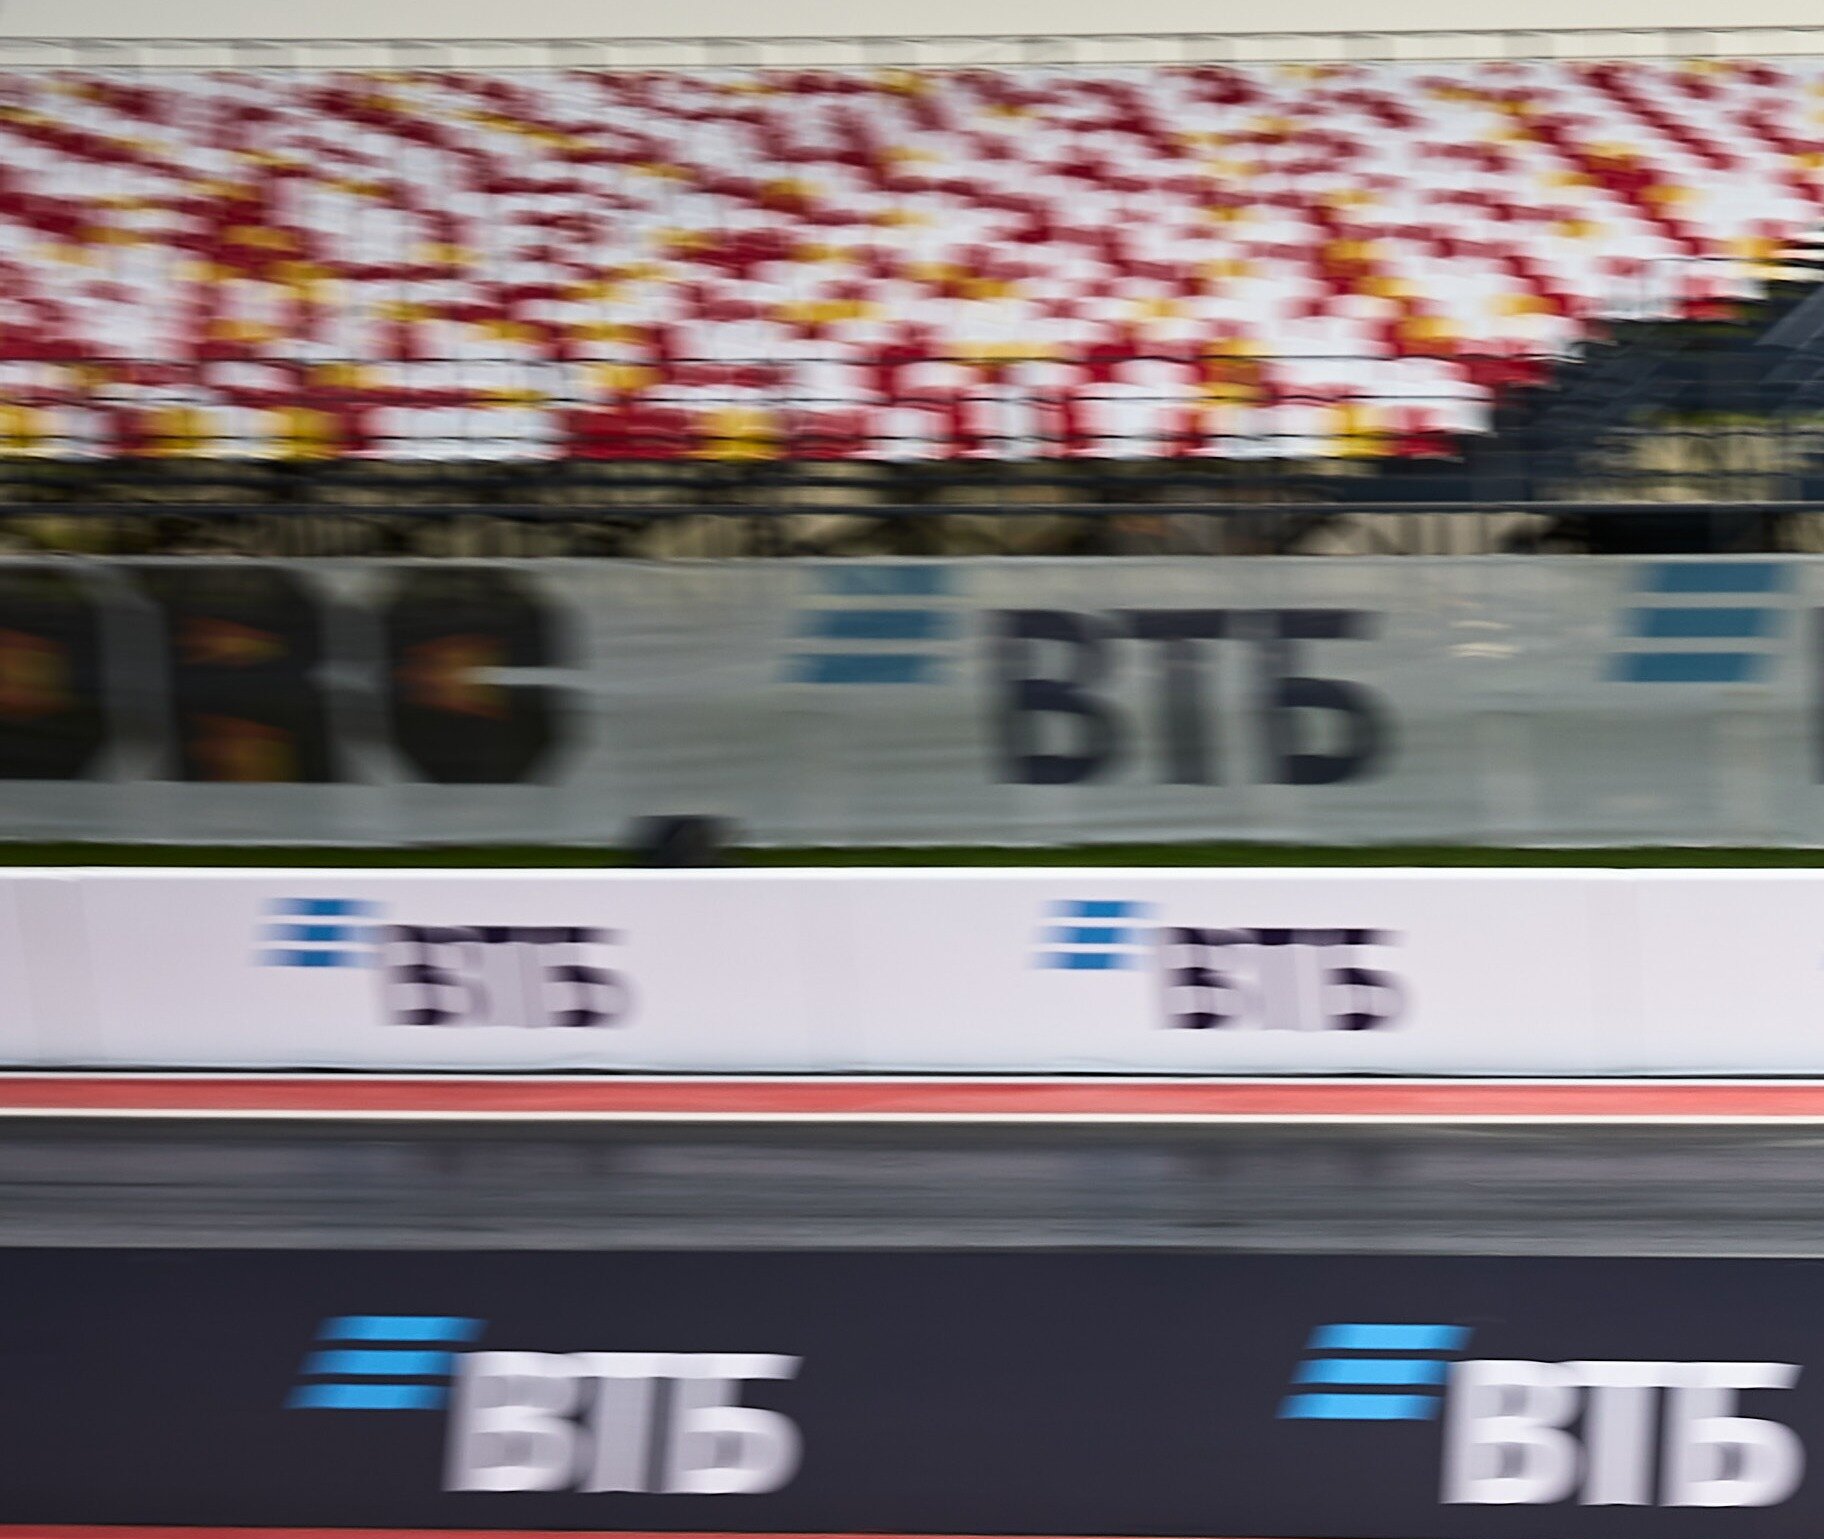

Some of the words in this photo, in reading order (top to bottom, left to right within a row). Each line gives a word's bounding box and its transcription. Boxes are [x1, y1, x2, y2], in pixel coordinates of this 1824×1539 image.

[988, 607, 1392, 786] ВТБ
[380, 924, 632, 1028] ВТБ
[1161, 926, 1405, 1031] ВТБ
[443, 1350, 803, 1495] ВТБ
[1441, 1359, 1805, 1508] ВТБ
